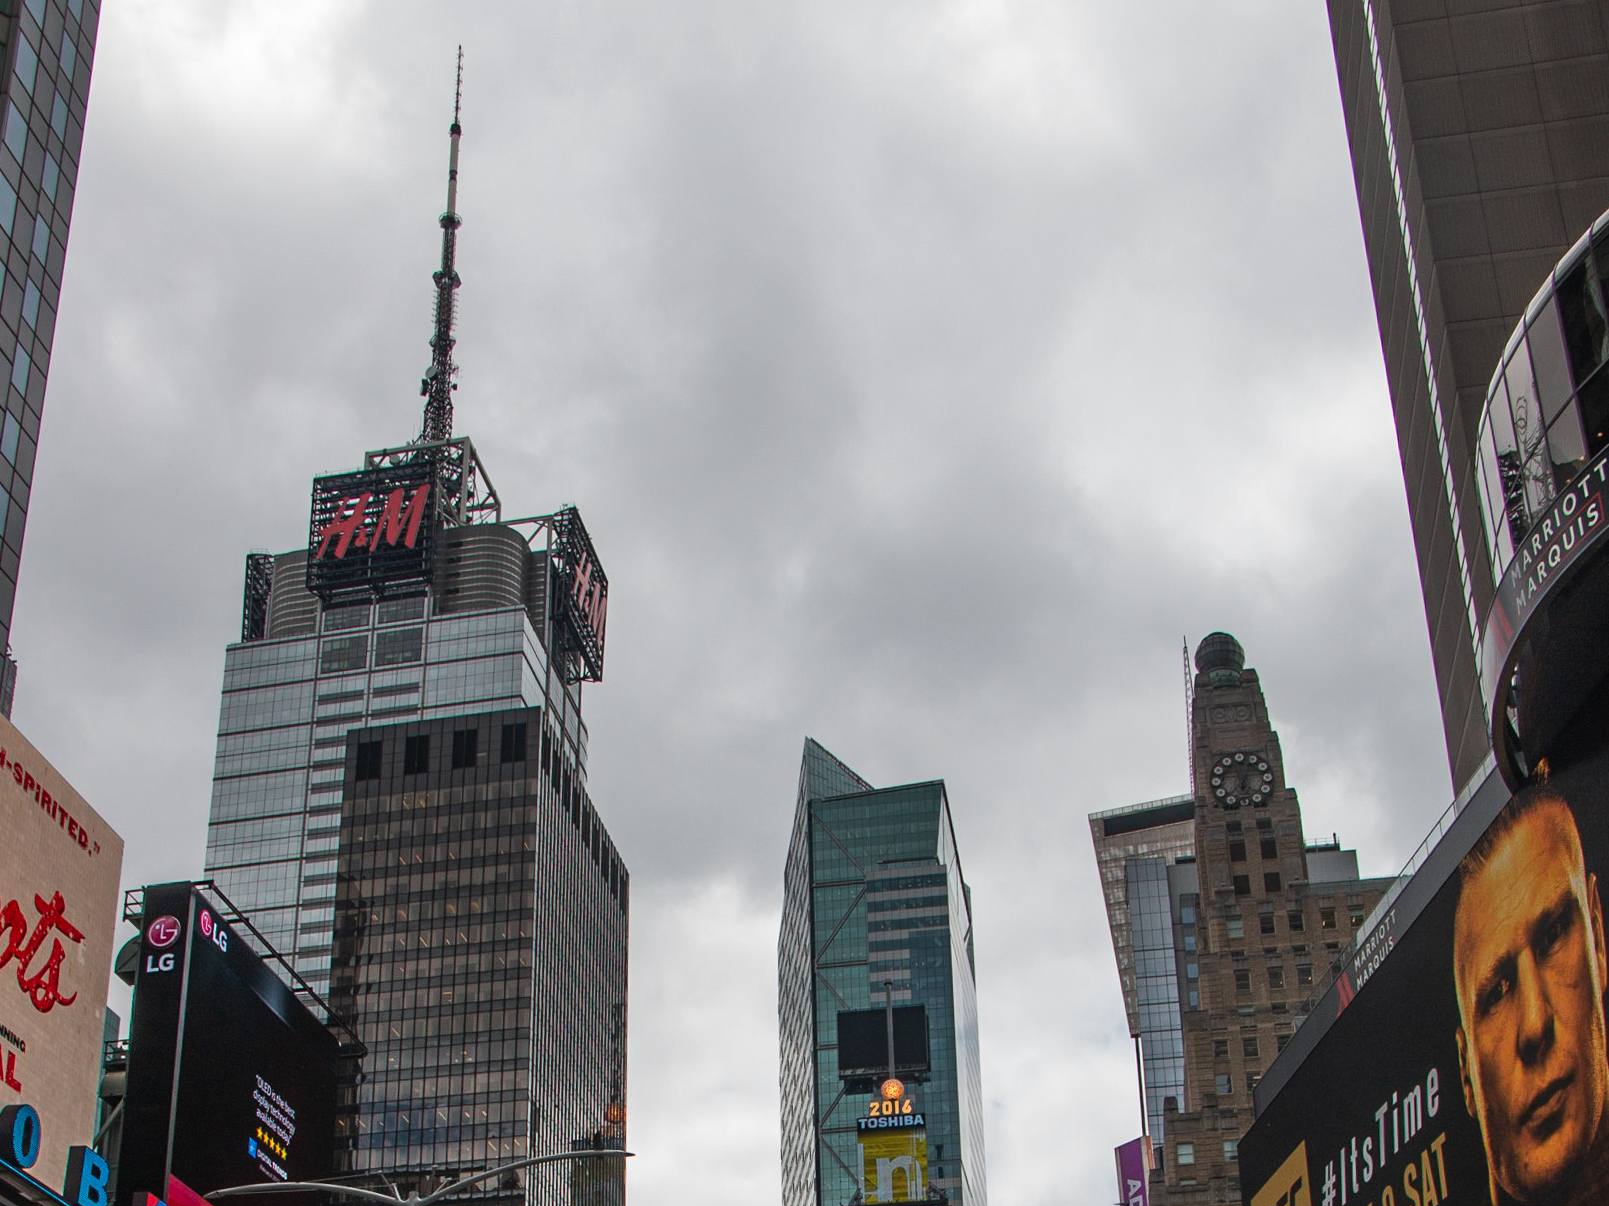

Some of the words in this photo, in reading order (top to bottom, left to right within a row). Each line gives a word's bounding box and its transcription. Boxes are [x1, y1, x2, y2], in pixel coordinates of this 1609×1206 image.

[316, 484, 431, 560] H&M
[1510, 457, 1609, 588] MARRIOTT
[1514, 503, 1600, 617] MARQUIS
[146, 953, 175, 973] LG
[212, 922, 228, 953] LG
[1353, 909, 1398, 969] MARRIOTT
[1356, 936, 1395, 991] MARQUIS
[252, 1089, 270, 1113] display
[270, 1104, 296, 1136] technology
[276, 1094, 285, 1109] the
[858, 1114, 925, 1130] TOSHIBA
